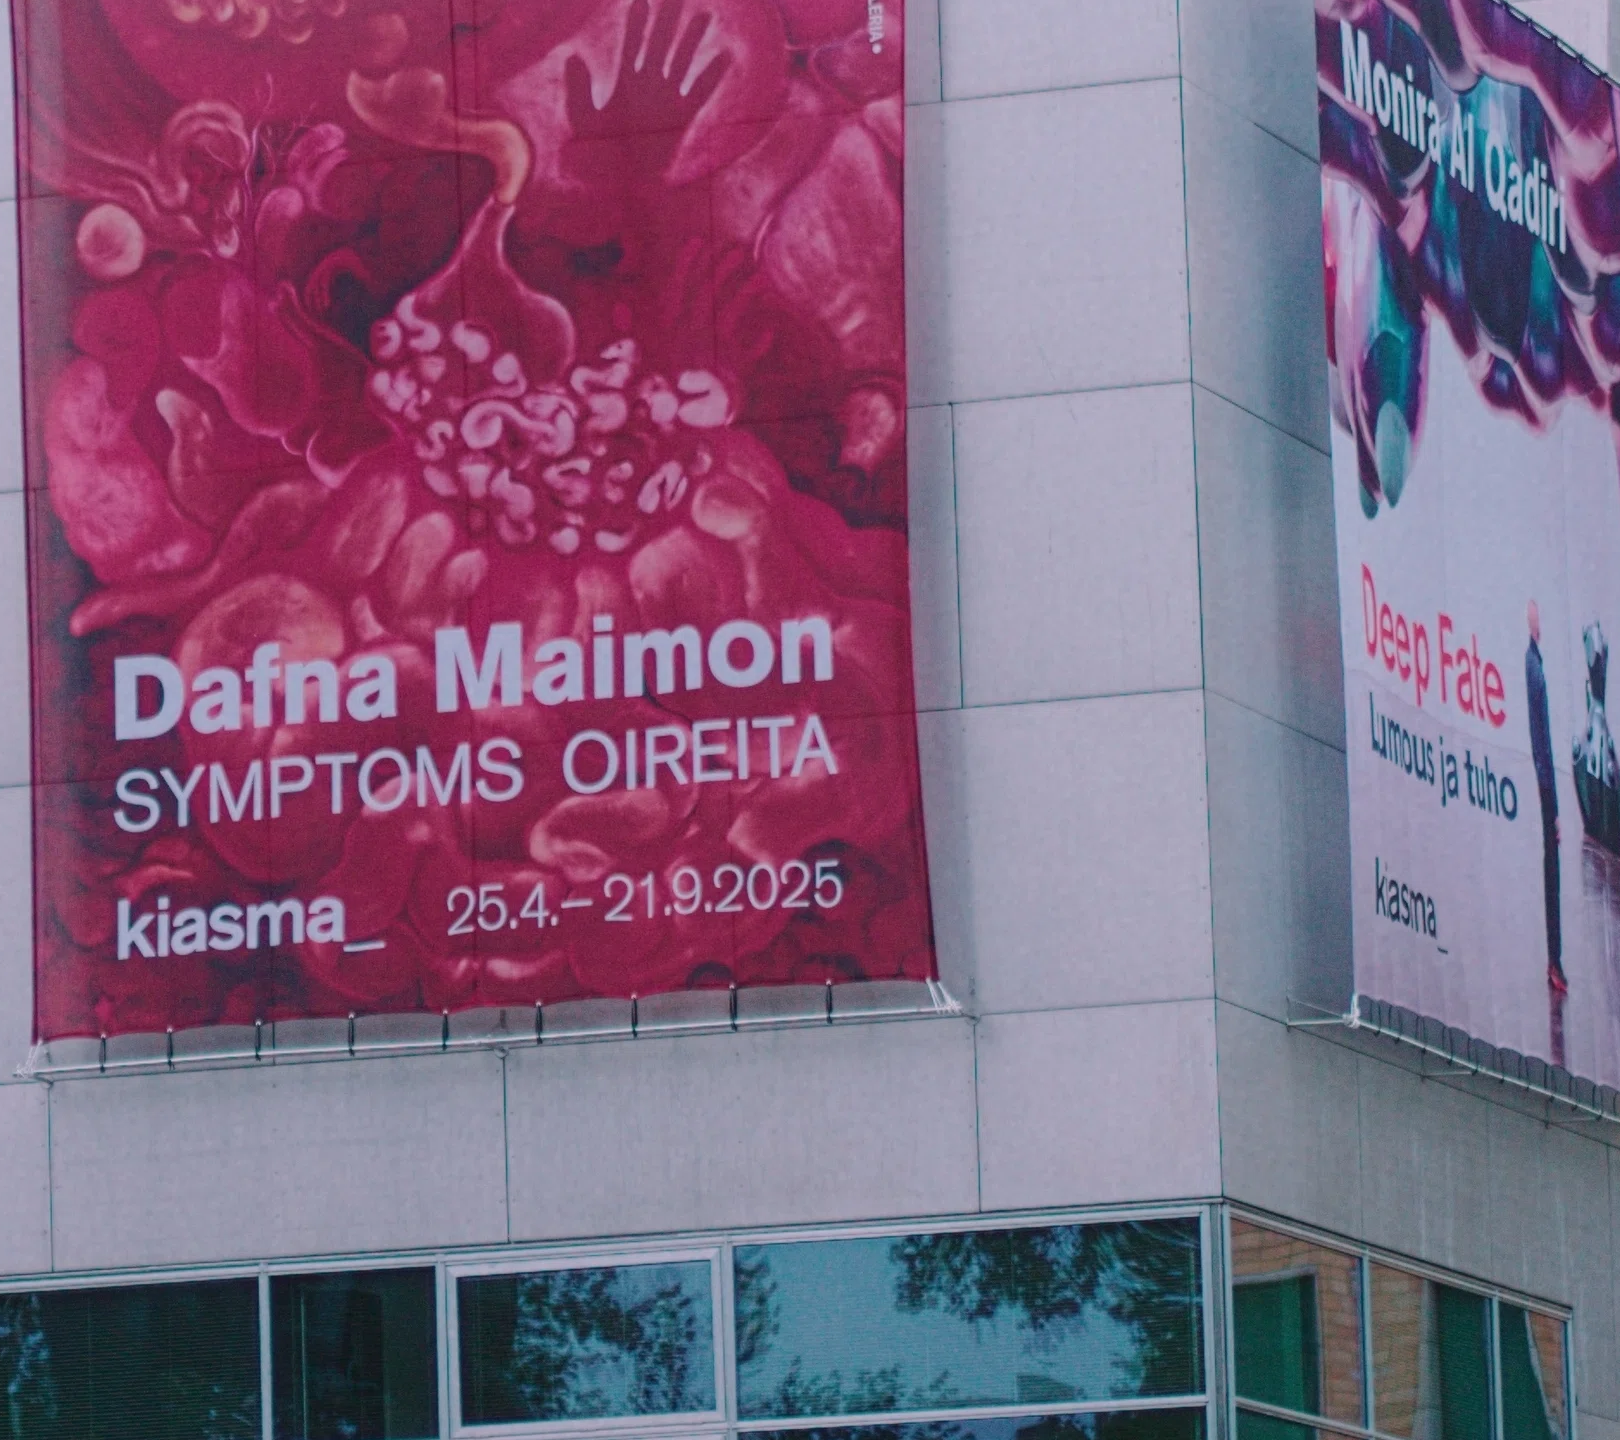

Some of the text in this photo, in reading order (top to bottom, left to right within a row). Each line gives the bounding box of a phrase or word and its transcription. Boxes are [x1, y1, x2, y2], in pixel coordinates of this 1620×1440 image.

[1340, 18, 1444, 168] Monira
[1449, 104, 1474, 193] Al
[1484, 128, 1566, 254] Qadiri
[113, 613, 834, 741] Dafna Maimon
[1362, 562, 1506, 728] Deep Fate
[113, 714, 839, 834] SYMPTOMS OIREITA
[1369, 691, 1518, 821] Lumous ja tuho
